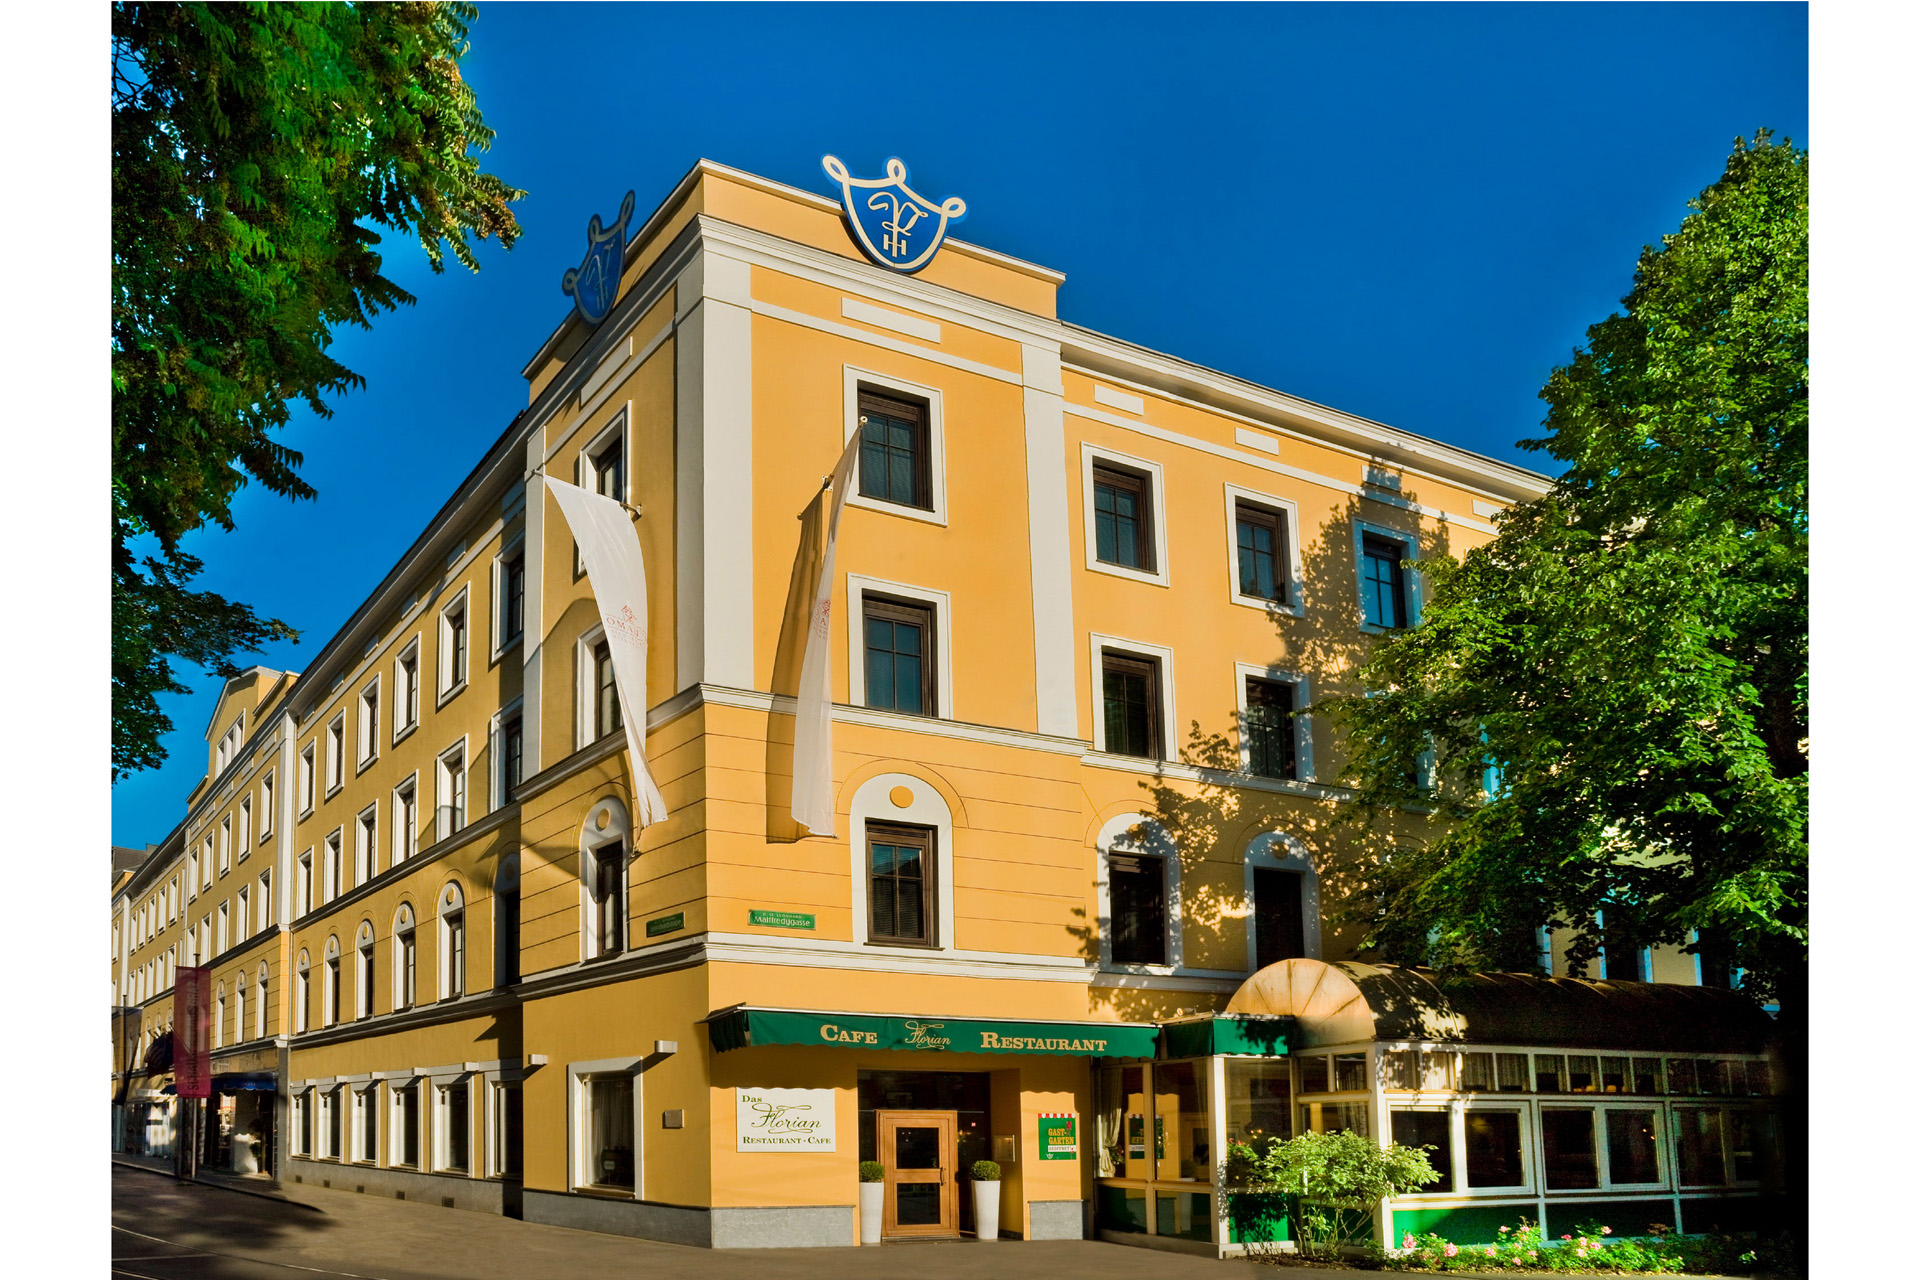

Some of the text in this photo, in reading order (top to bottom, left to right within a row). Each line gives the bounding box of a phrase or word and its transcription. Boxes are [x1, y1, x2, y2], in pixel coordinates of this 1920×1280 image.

[820, 1020, 1107, 1051] CAFE Florian RESTAURANT
[742, 1095, 763, 1103] Das
[751, 1102, 822, 1134] Florian
[743, 1136, 832, 1144] RESTAURANT CAFE
[1048, 1136, 1074, 1144] GARTEN
